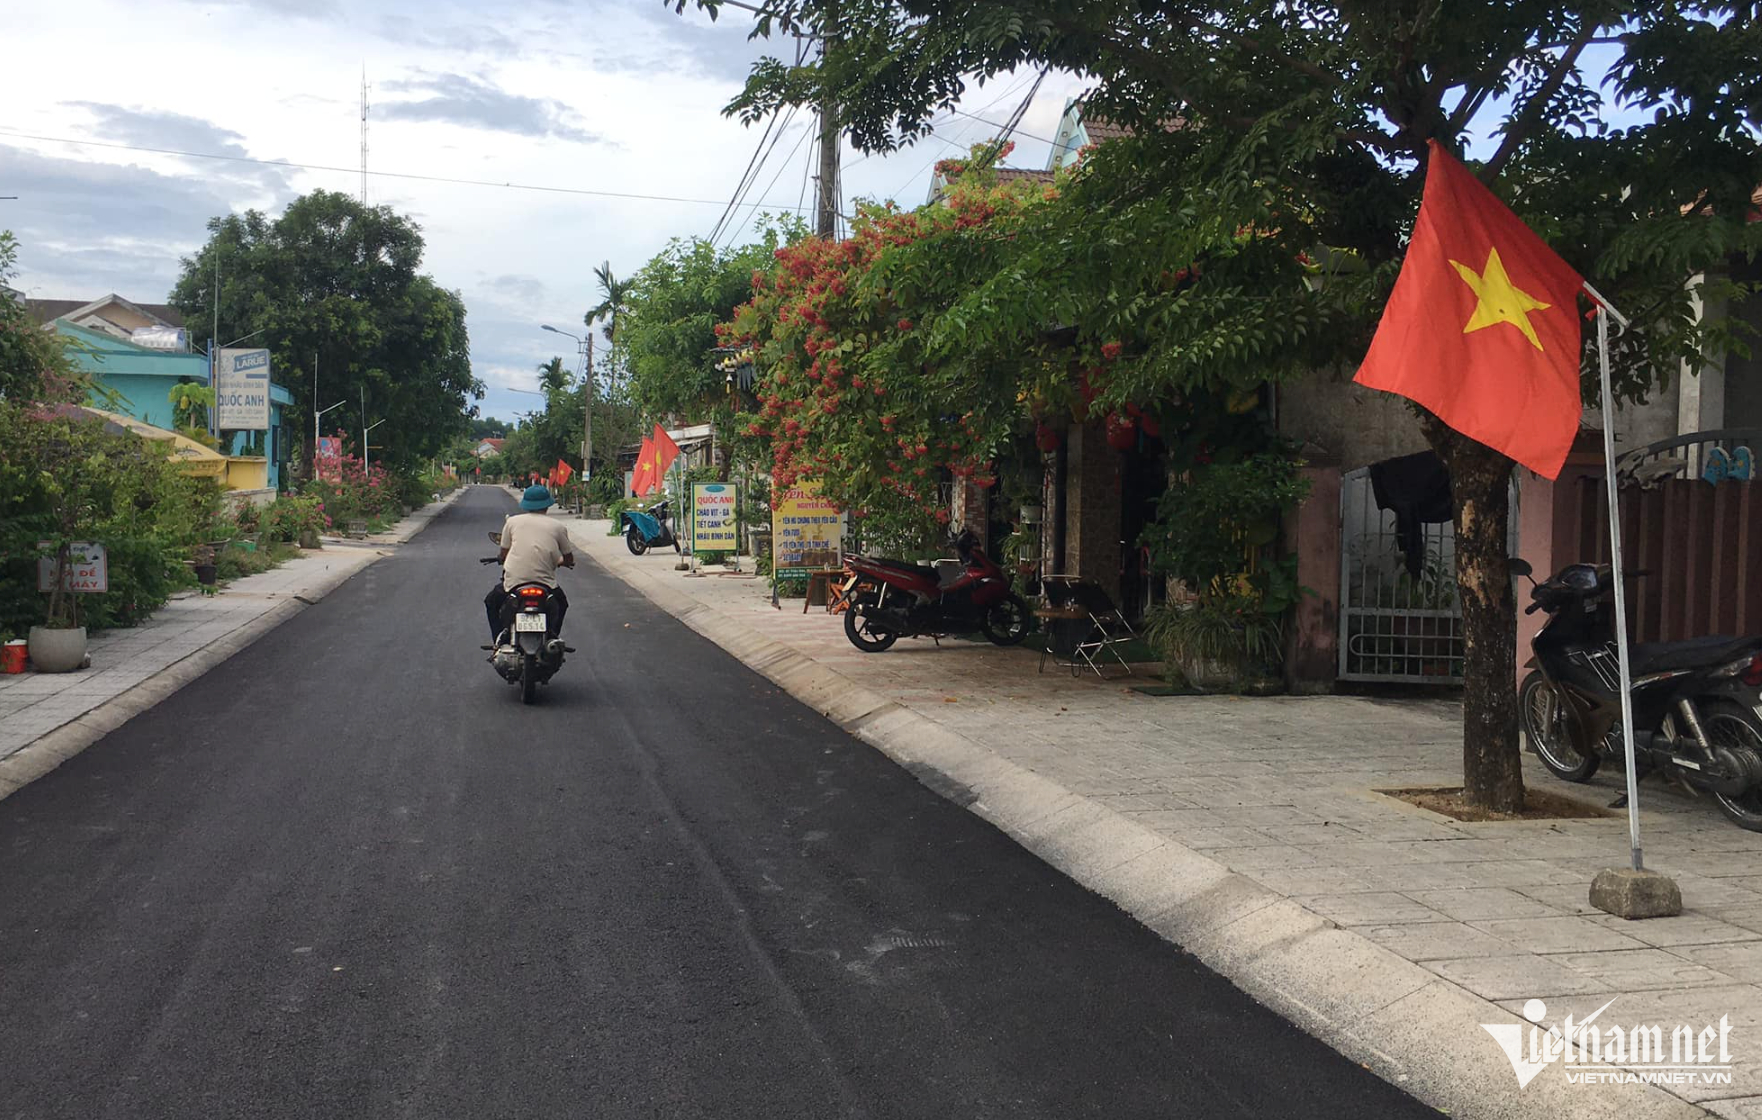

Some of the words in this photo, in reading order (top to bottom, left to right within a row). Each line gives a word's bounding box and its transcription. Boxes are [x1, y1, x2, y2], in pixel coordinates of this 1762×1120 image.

[236, 356, 266, 369] LARUE
[244, 394, 265, 406] ANH
[719, 496, 735, 504] ANH
